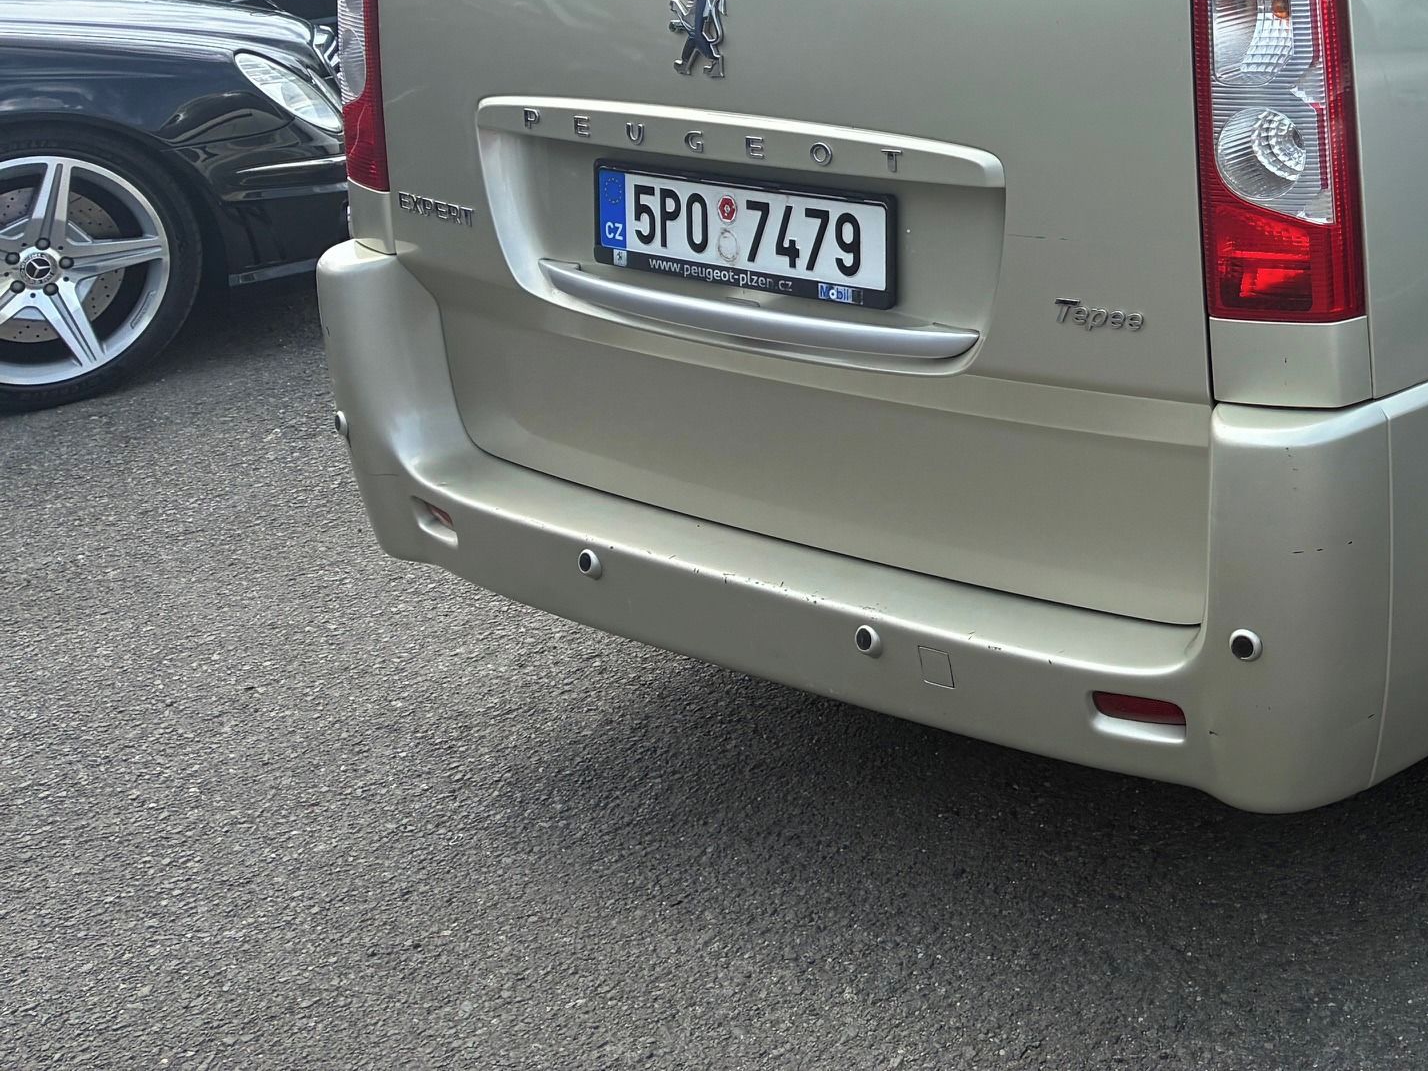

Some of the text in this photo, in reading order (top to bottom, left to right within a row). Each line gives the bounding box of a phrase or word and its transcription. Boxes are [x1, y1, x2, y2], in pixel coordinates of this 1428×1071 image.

[523, 107, 902, 173] PEUGEOT
[398, 191, 474, 228] EXPERT
[605, 221, 624, 241] CZ
[746, 199, 861, 277] 7479
[648, 257, 793, 292] www.peugeot-plzen.cz
[1054, 297, 1144, 332] Tepee
